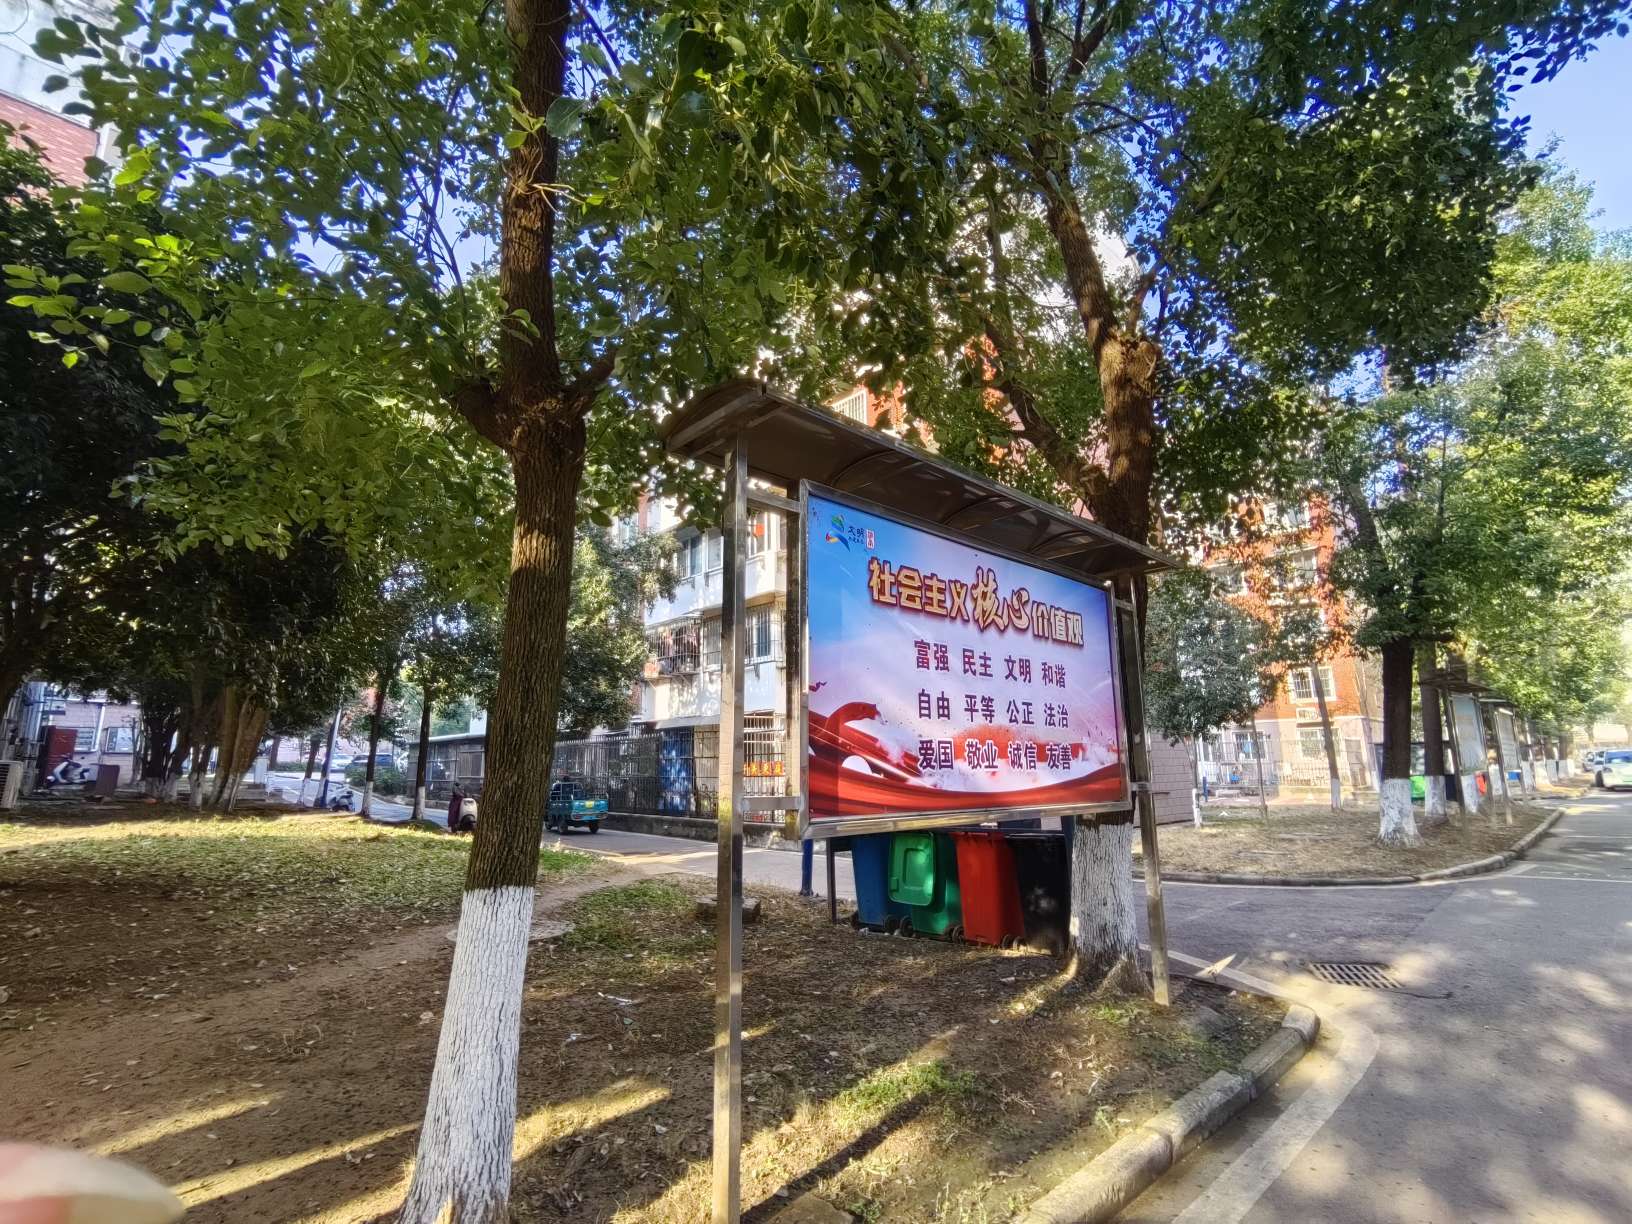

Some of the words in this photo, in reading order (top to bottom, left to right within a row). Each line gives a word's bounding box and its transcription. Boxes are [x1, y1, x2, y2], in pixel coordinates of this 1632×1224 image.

[868, 556, 1084, 648] 社会主义核心价值观
[914, 639, 950, 672] 富强
[962, 648, 993, 678] 民主
[1004, 655, 1032, 684] 文明
[1041, 662, 1066, 689] 和谐
[918, 689, 950, 720] 自由
[964, 694, 995, 724] 平等
[1006, 699, 1035, 725] 公正
[1044, 703, 1069, 729] 法治
[918, 739, 954, 771] 爱国
[966, 740, 999, 770] 敬业
[1008, 742, 1037, 770] 诚信
[1046, 743, 1072, 770] 友善
